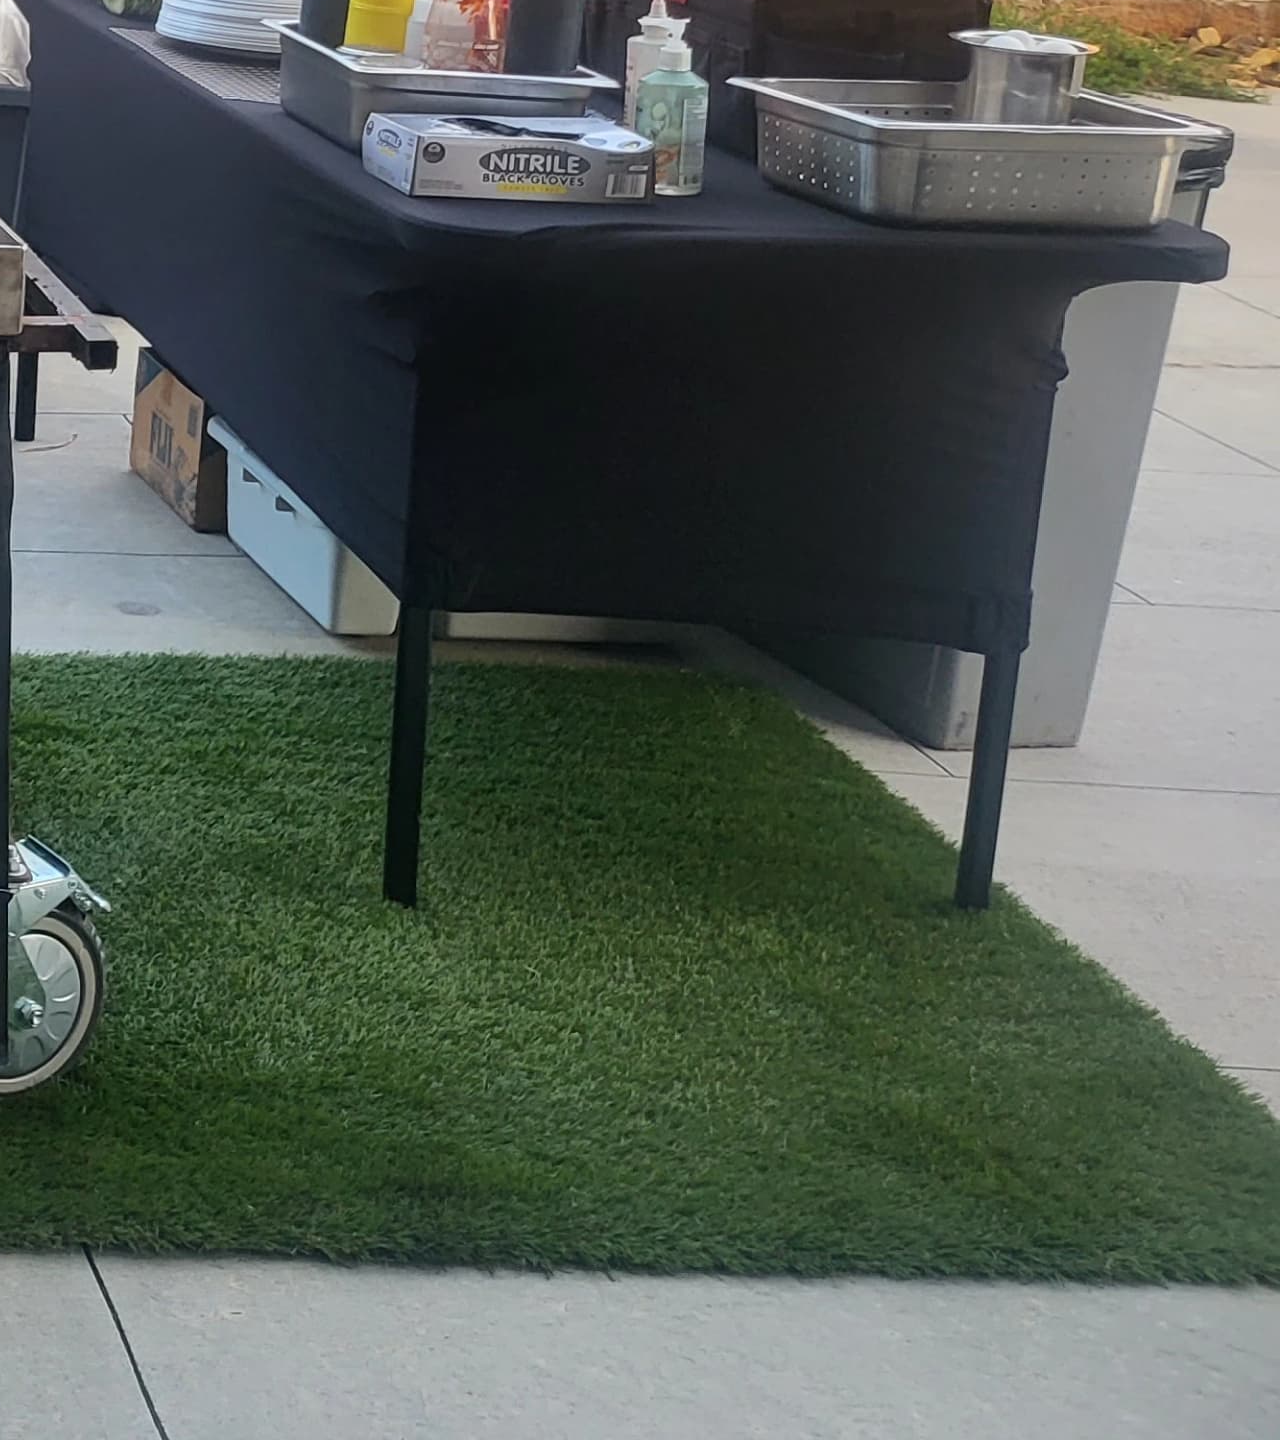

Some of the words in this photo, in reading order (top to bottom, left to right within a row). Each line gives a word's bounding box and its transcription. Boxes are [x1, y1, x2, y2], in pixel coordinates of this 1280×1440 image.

[488, 152, 581, 174] NITRILE
[482, 172, 525, 184] BLACK
[530, 174, 585, 187] GLOVES
